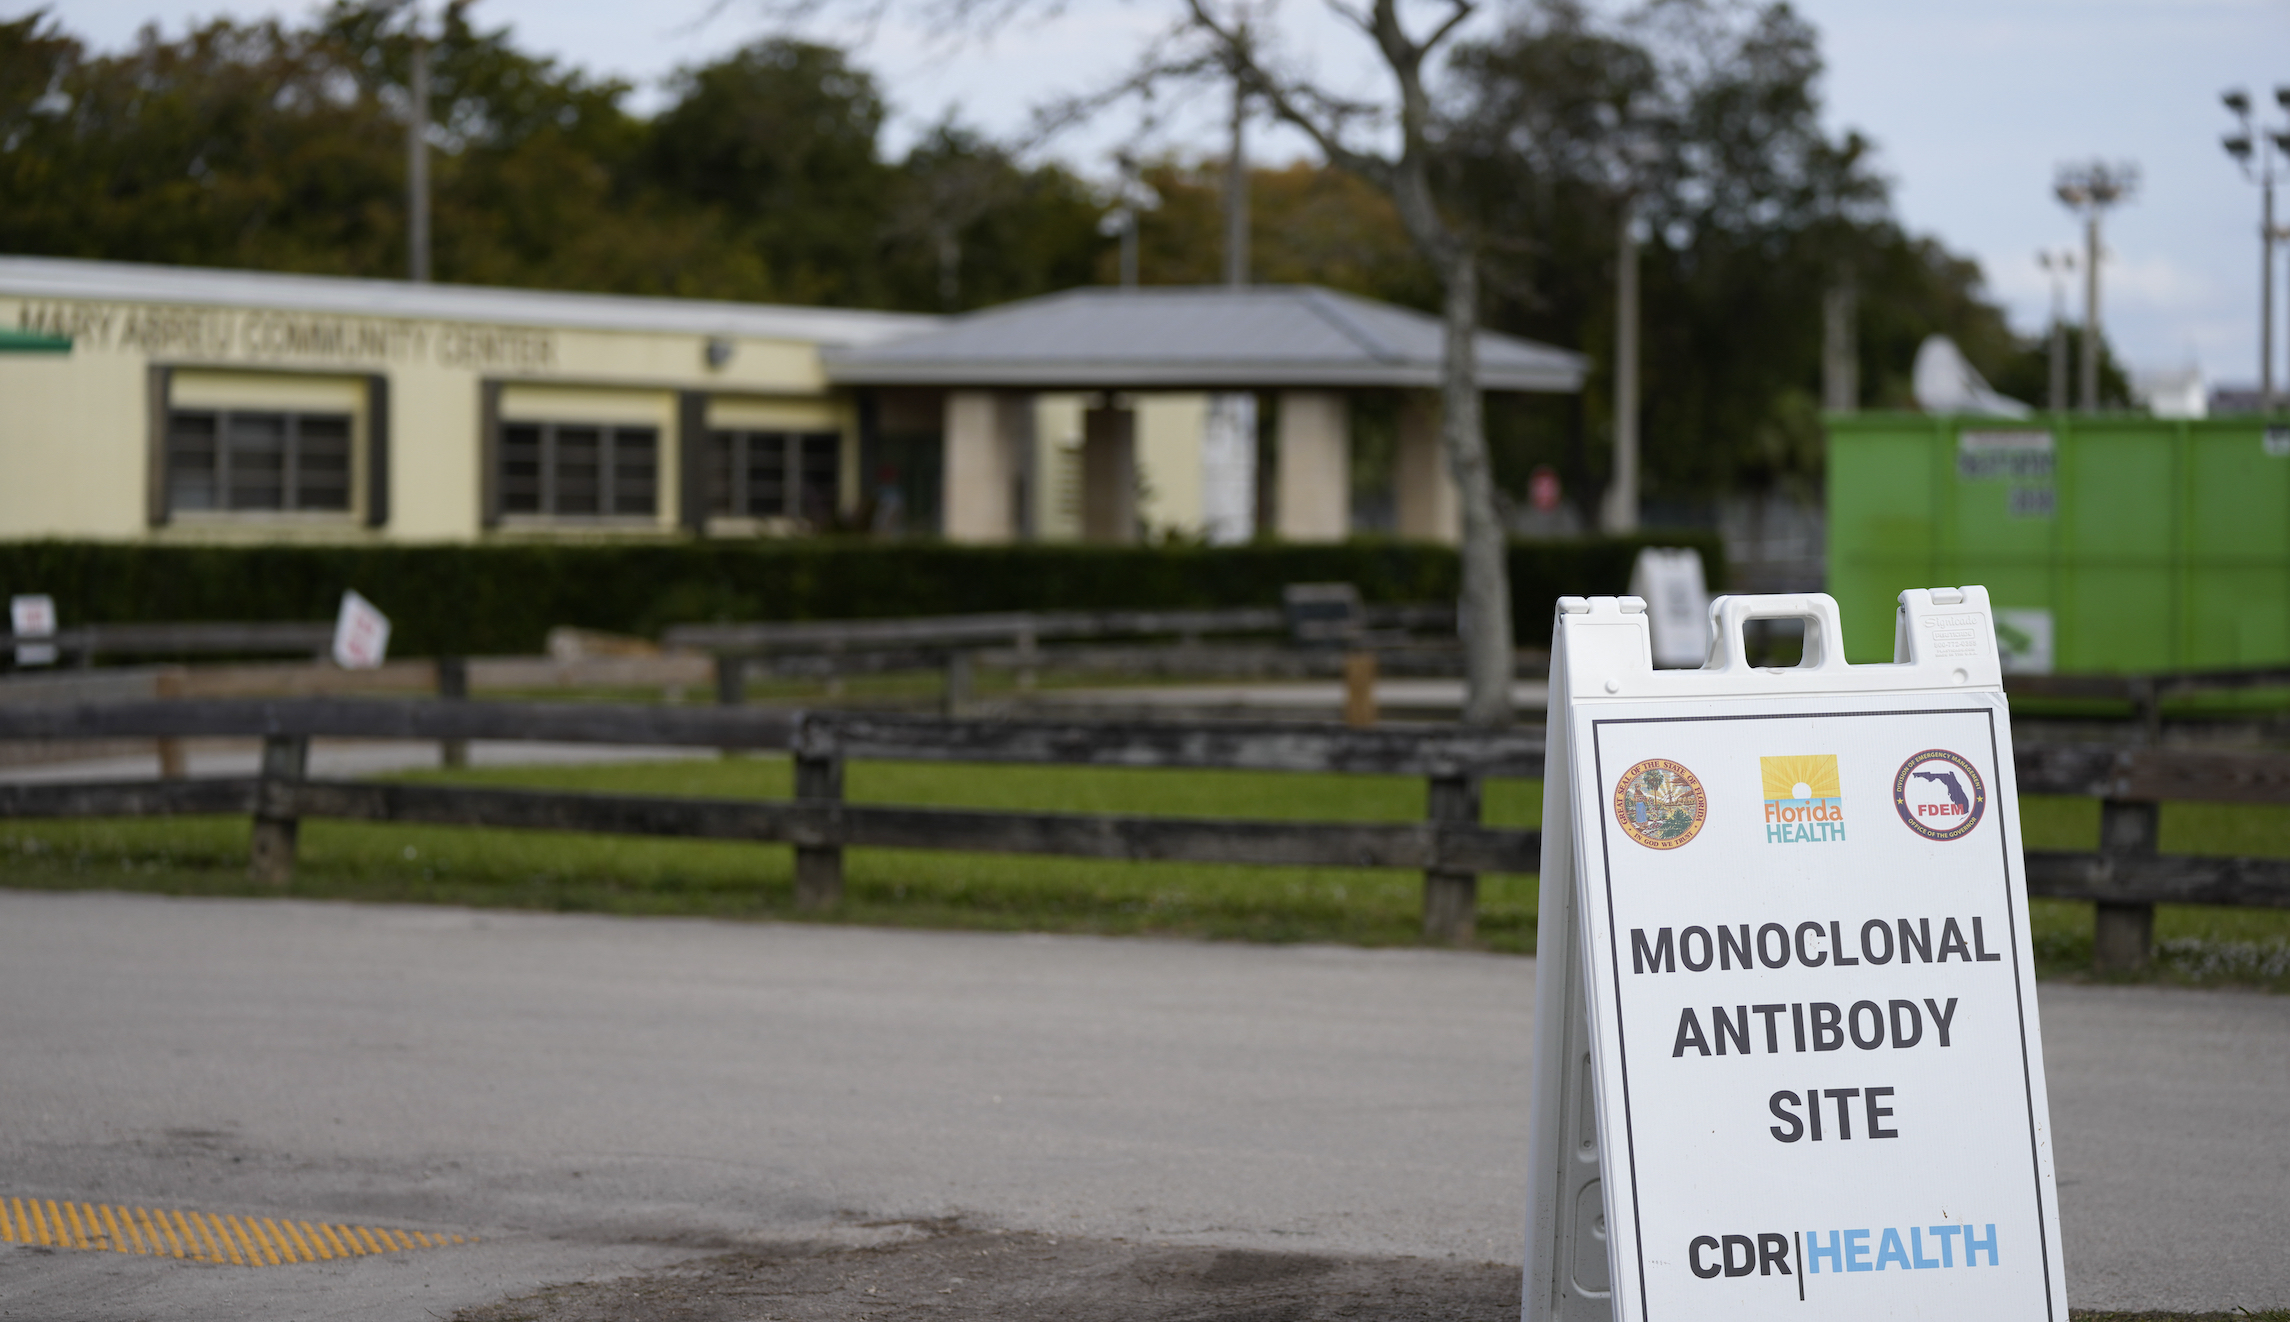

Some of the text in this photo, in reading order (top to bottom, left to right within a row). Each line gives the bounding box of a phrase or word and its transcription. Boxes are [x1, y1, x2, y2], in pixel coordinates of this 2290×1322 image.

[243, 313, 432, 365] COMMUNITY
[438, 325, 557, 370] CENTER
[1924, 615, 1978, 629] Signicade
[1896, 751, 1982, 792] DIVISION OF EMERGENCY MANAGEMENT
[1617, 761, 1705, 825] GREAT SEAL OF THE STATE OF FLORIDA
[1764, 798, 1844, 823] Florida
[1917, 803, 1965, 817] FDEM
[1633, 833, 1643, 841] IN
[1643, 838, 1659, 847] GOD
[1674, 831, 1693, 845] TRUST
[1766, 821, 1846, 844] HEALTH
[1908, 818, 1927, 834] OFFICE
[1949, 816, 1977, 838] GOVERNOR
[1630, 916, 2001, 975] MONOCLONAL
[1672, 997, 1959, 1058] ANTIBODY
[1768, 1086, 1899, 1143] SITE
[1688, 1223, 1999, 1279] CDR HEALTH
